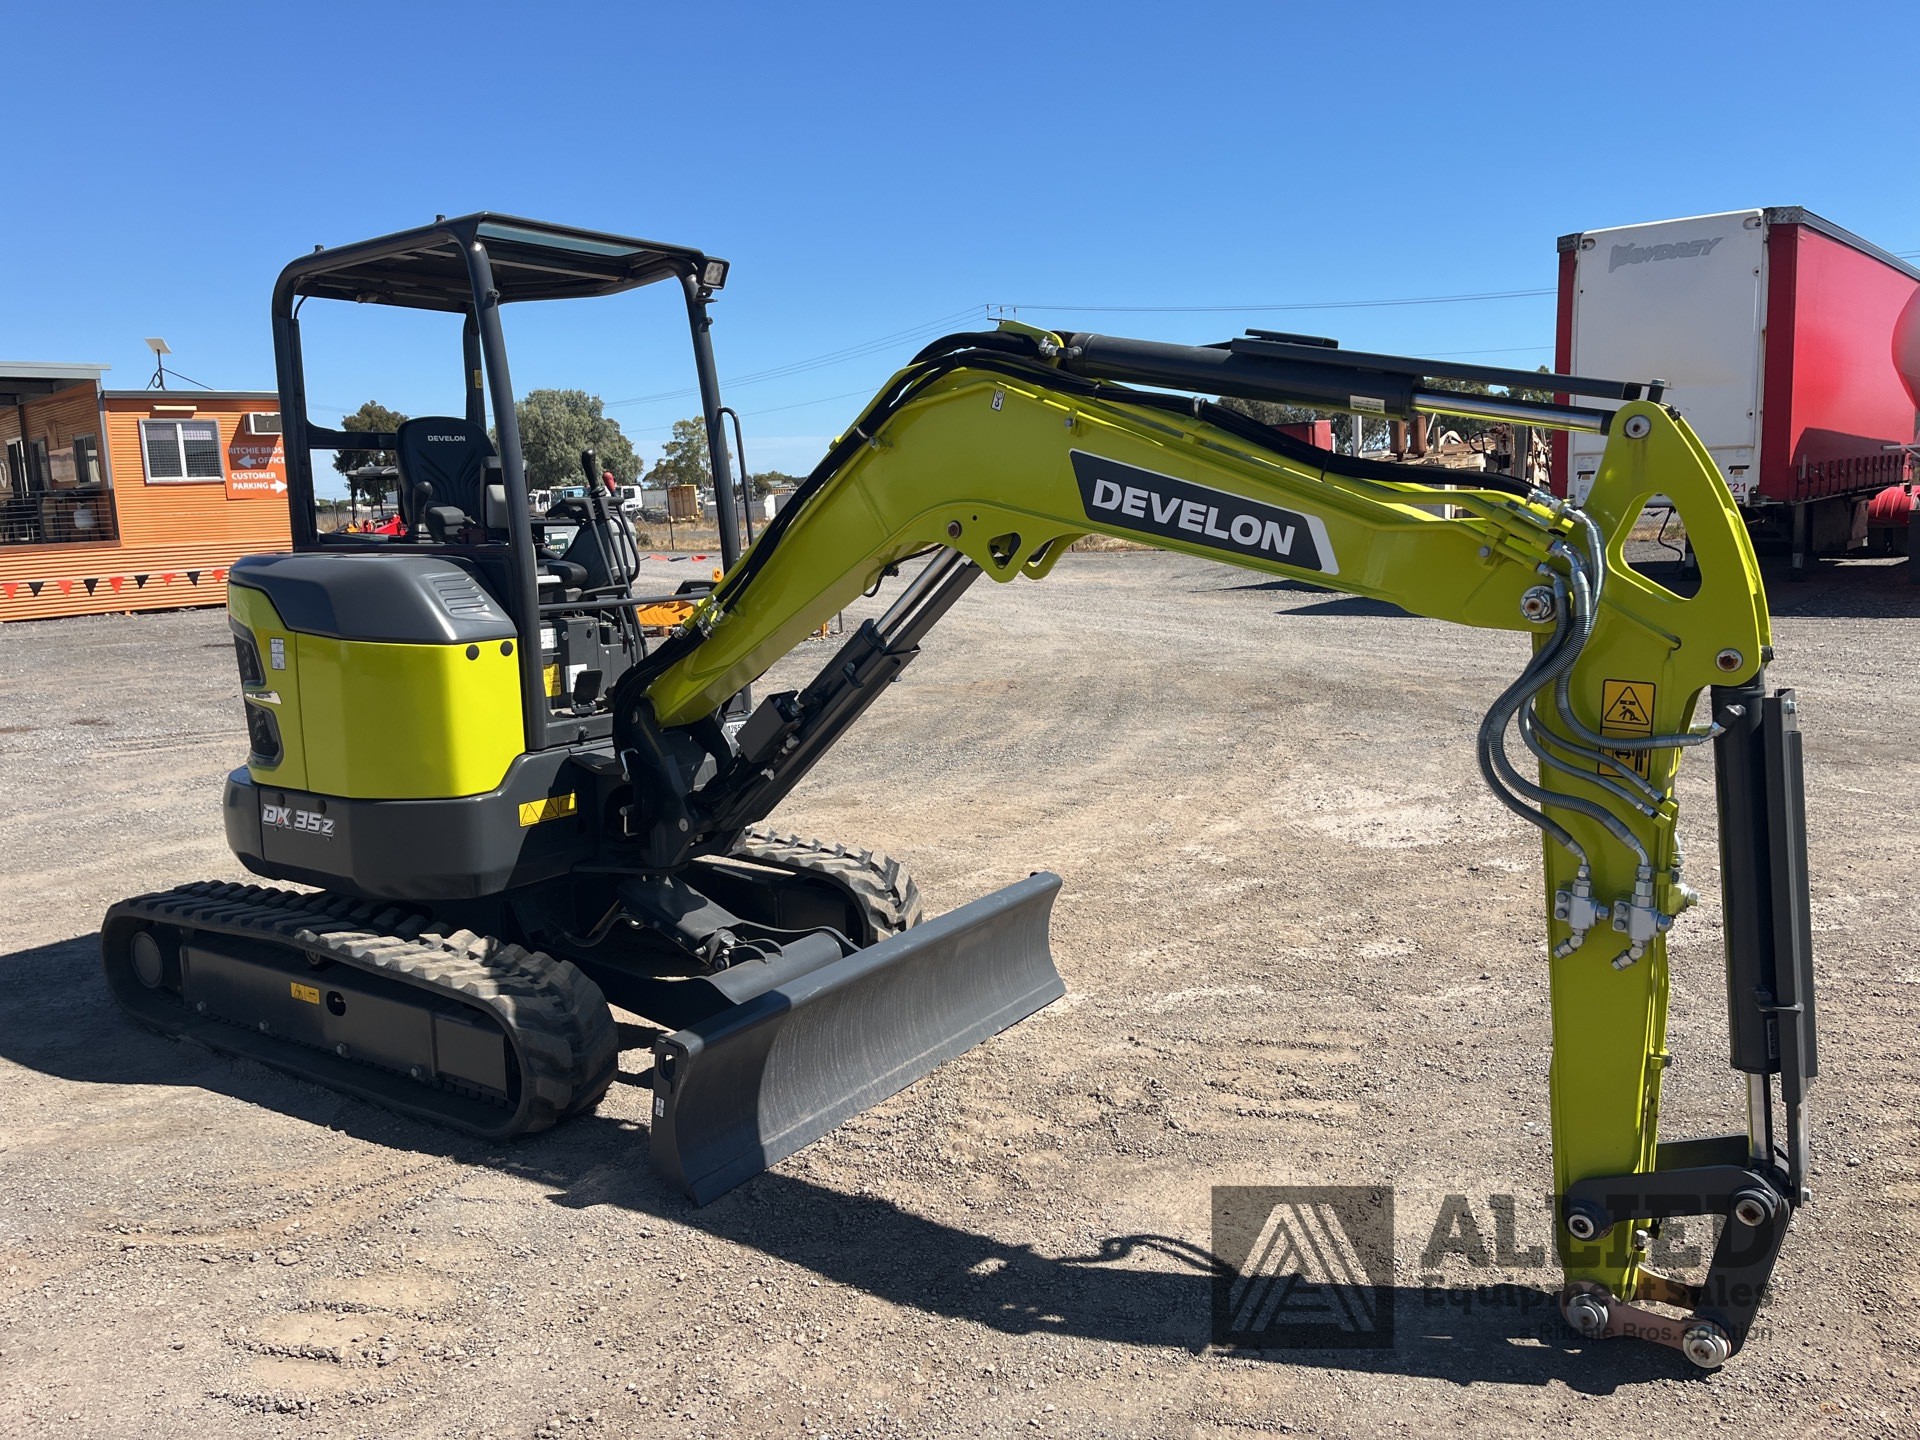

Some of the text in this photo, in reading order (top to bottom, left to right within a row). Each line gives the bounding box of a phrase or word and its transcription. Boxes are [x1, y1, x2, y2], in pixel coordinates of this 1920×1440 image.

[1608, 237, 1724, 273] VAWDREY
[231, 472, 276, 480] CUSTOMER
[233, 482, 269, 490] PARKING
[1092, 478, 1296, 556] DEVELON
[262, 803, 292, 829] DX
